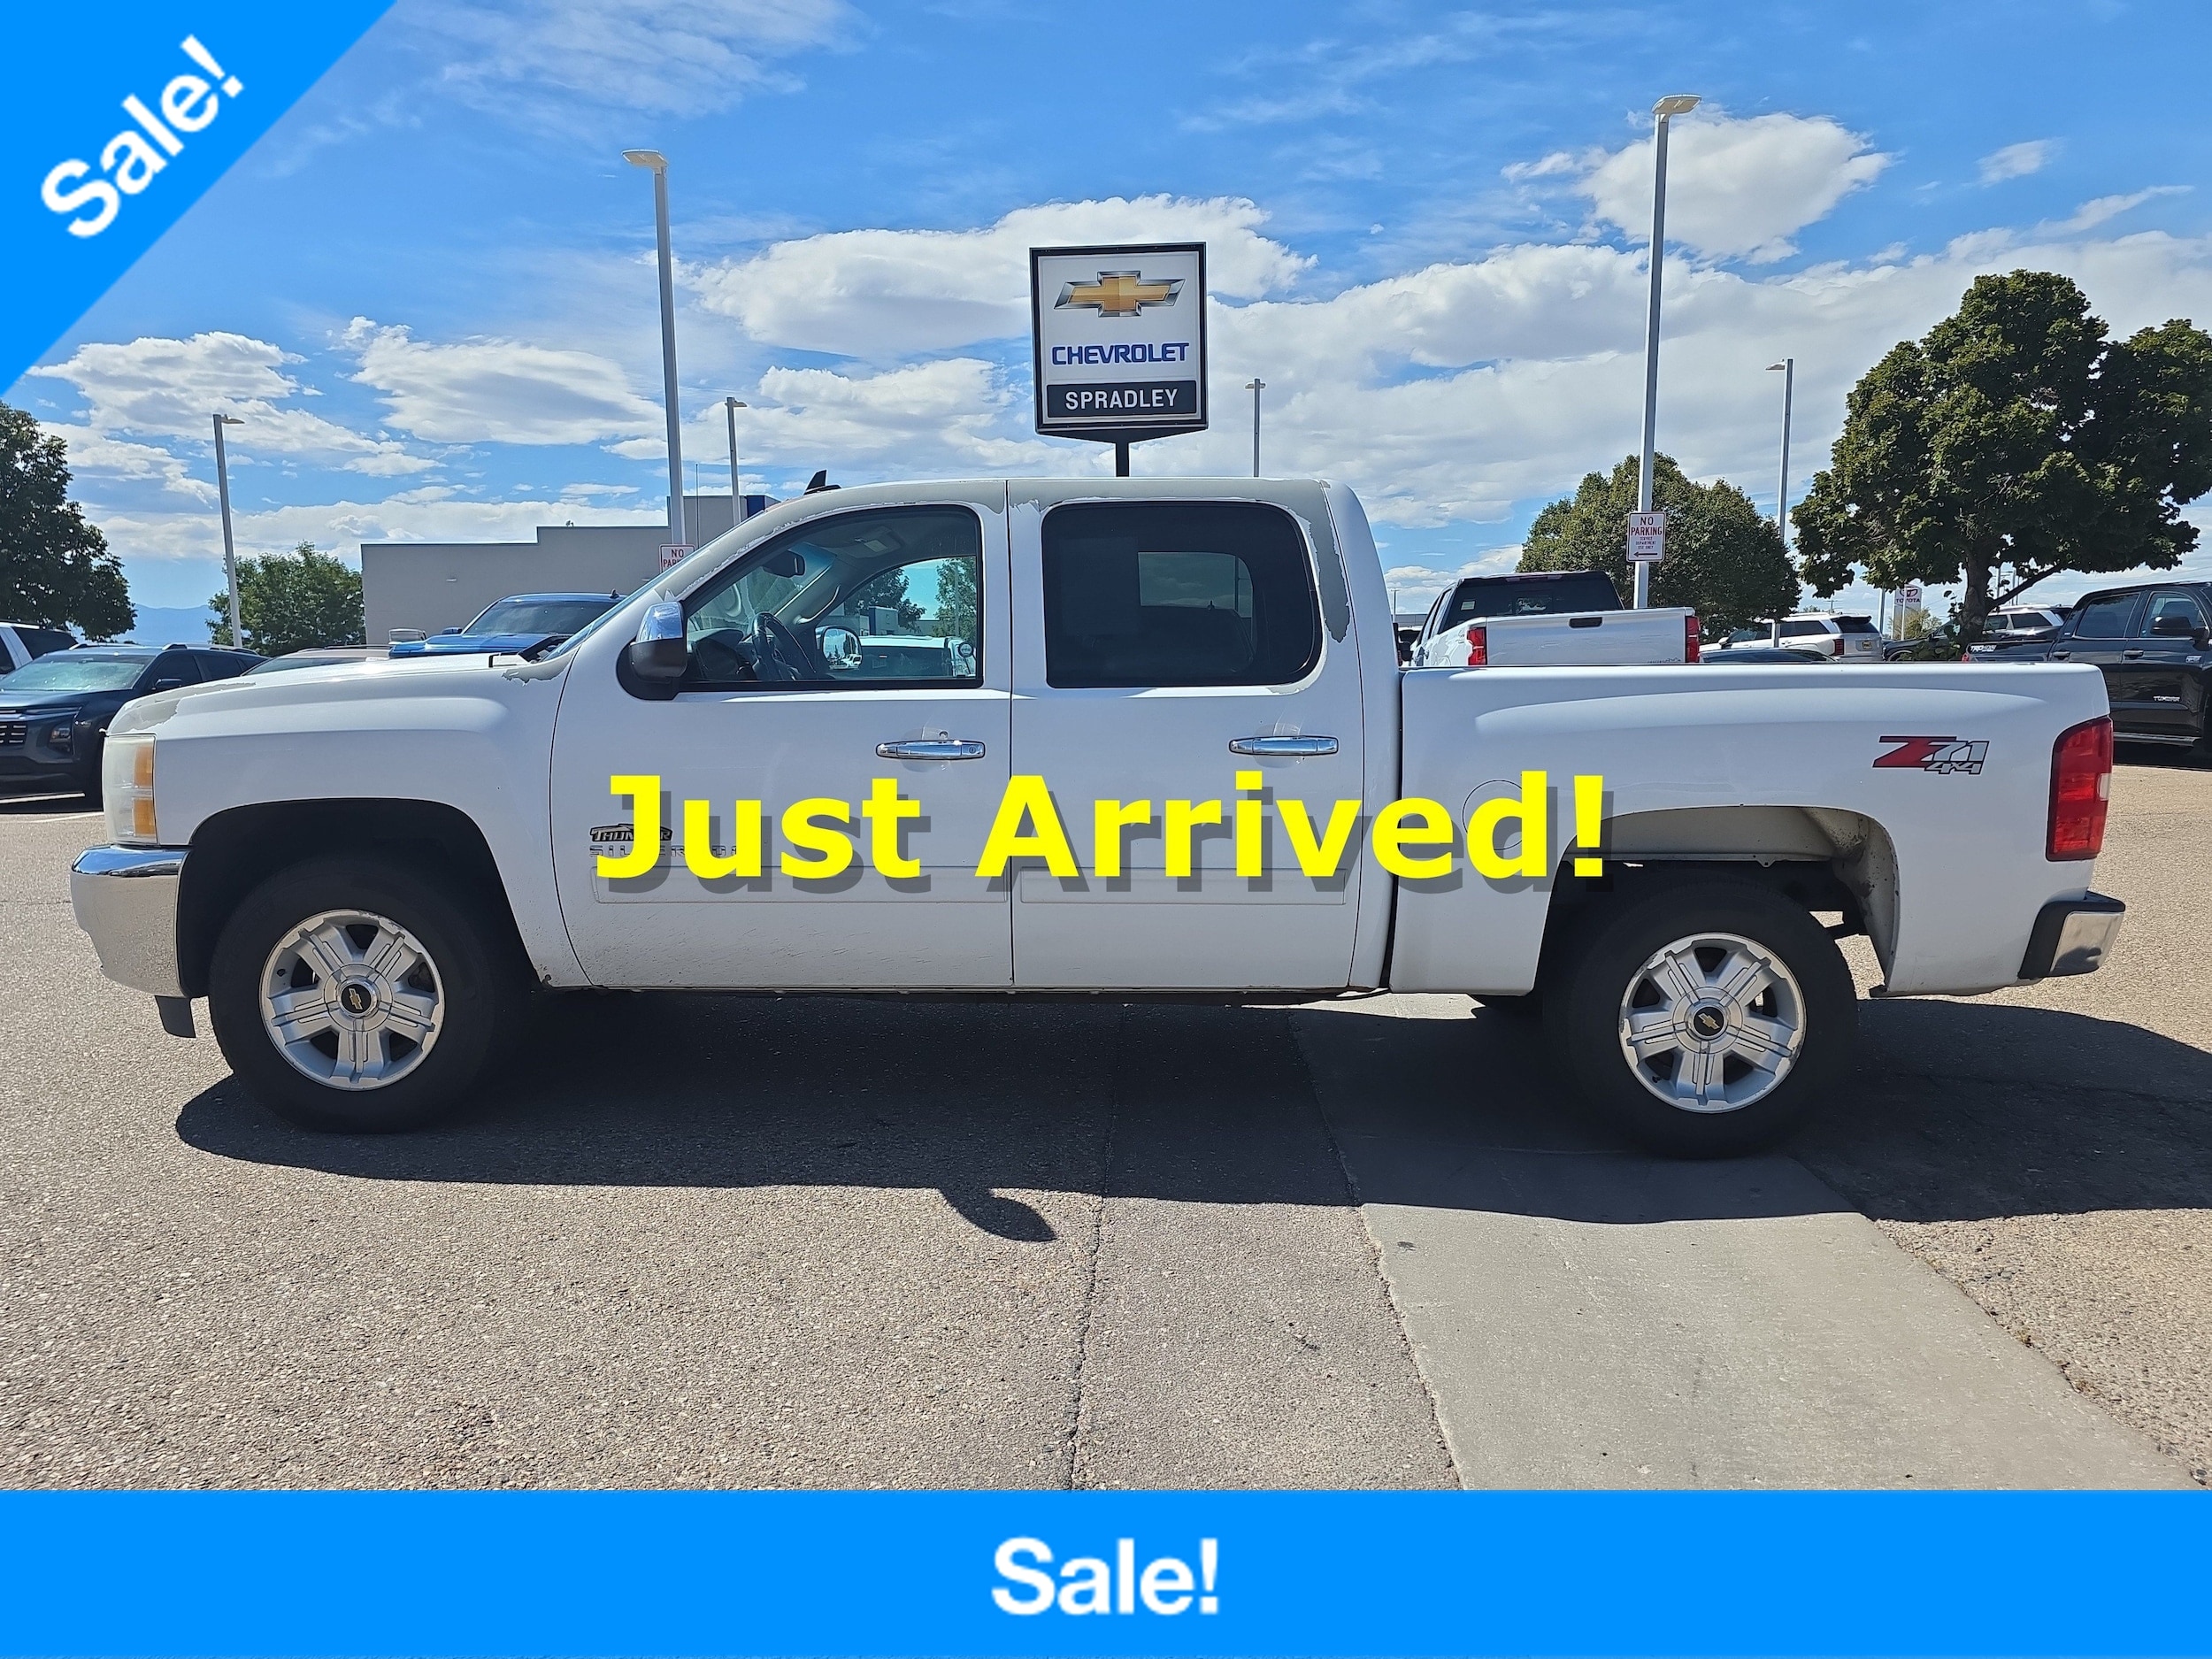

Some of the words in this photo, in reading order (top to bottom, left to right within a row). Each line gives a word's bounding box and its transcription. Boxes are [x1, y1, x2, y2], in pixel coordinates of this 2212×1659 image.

[1052, 342, 1189, 365] CHEVROLET
[1065, 388, 1178, 410] SPRADLEY
[1640, 517, 1654, 526] NO
[1631, 526, 1662, 535] PARKING
[671, 549, 684, 557] NO
[1872, 736, 1990, 768] Z71
[591, 828, 672, 841] THUNR
